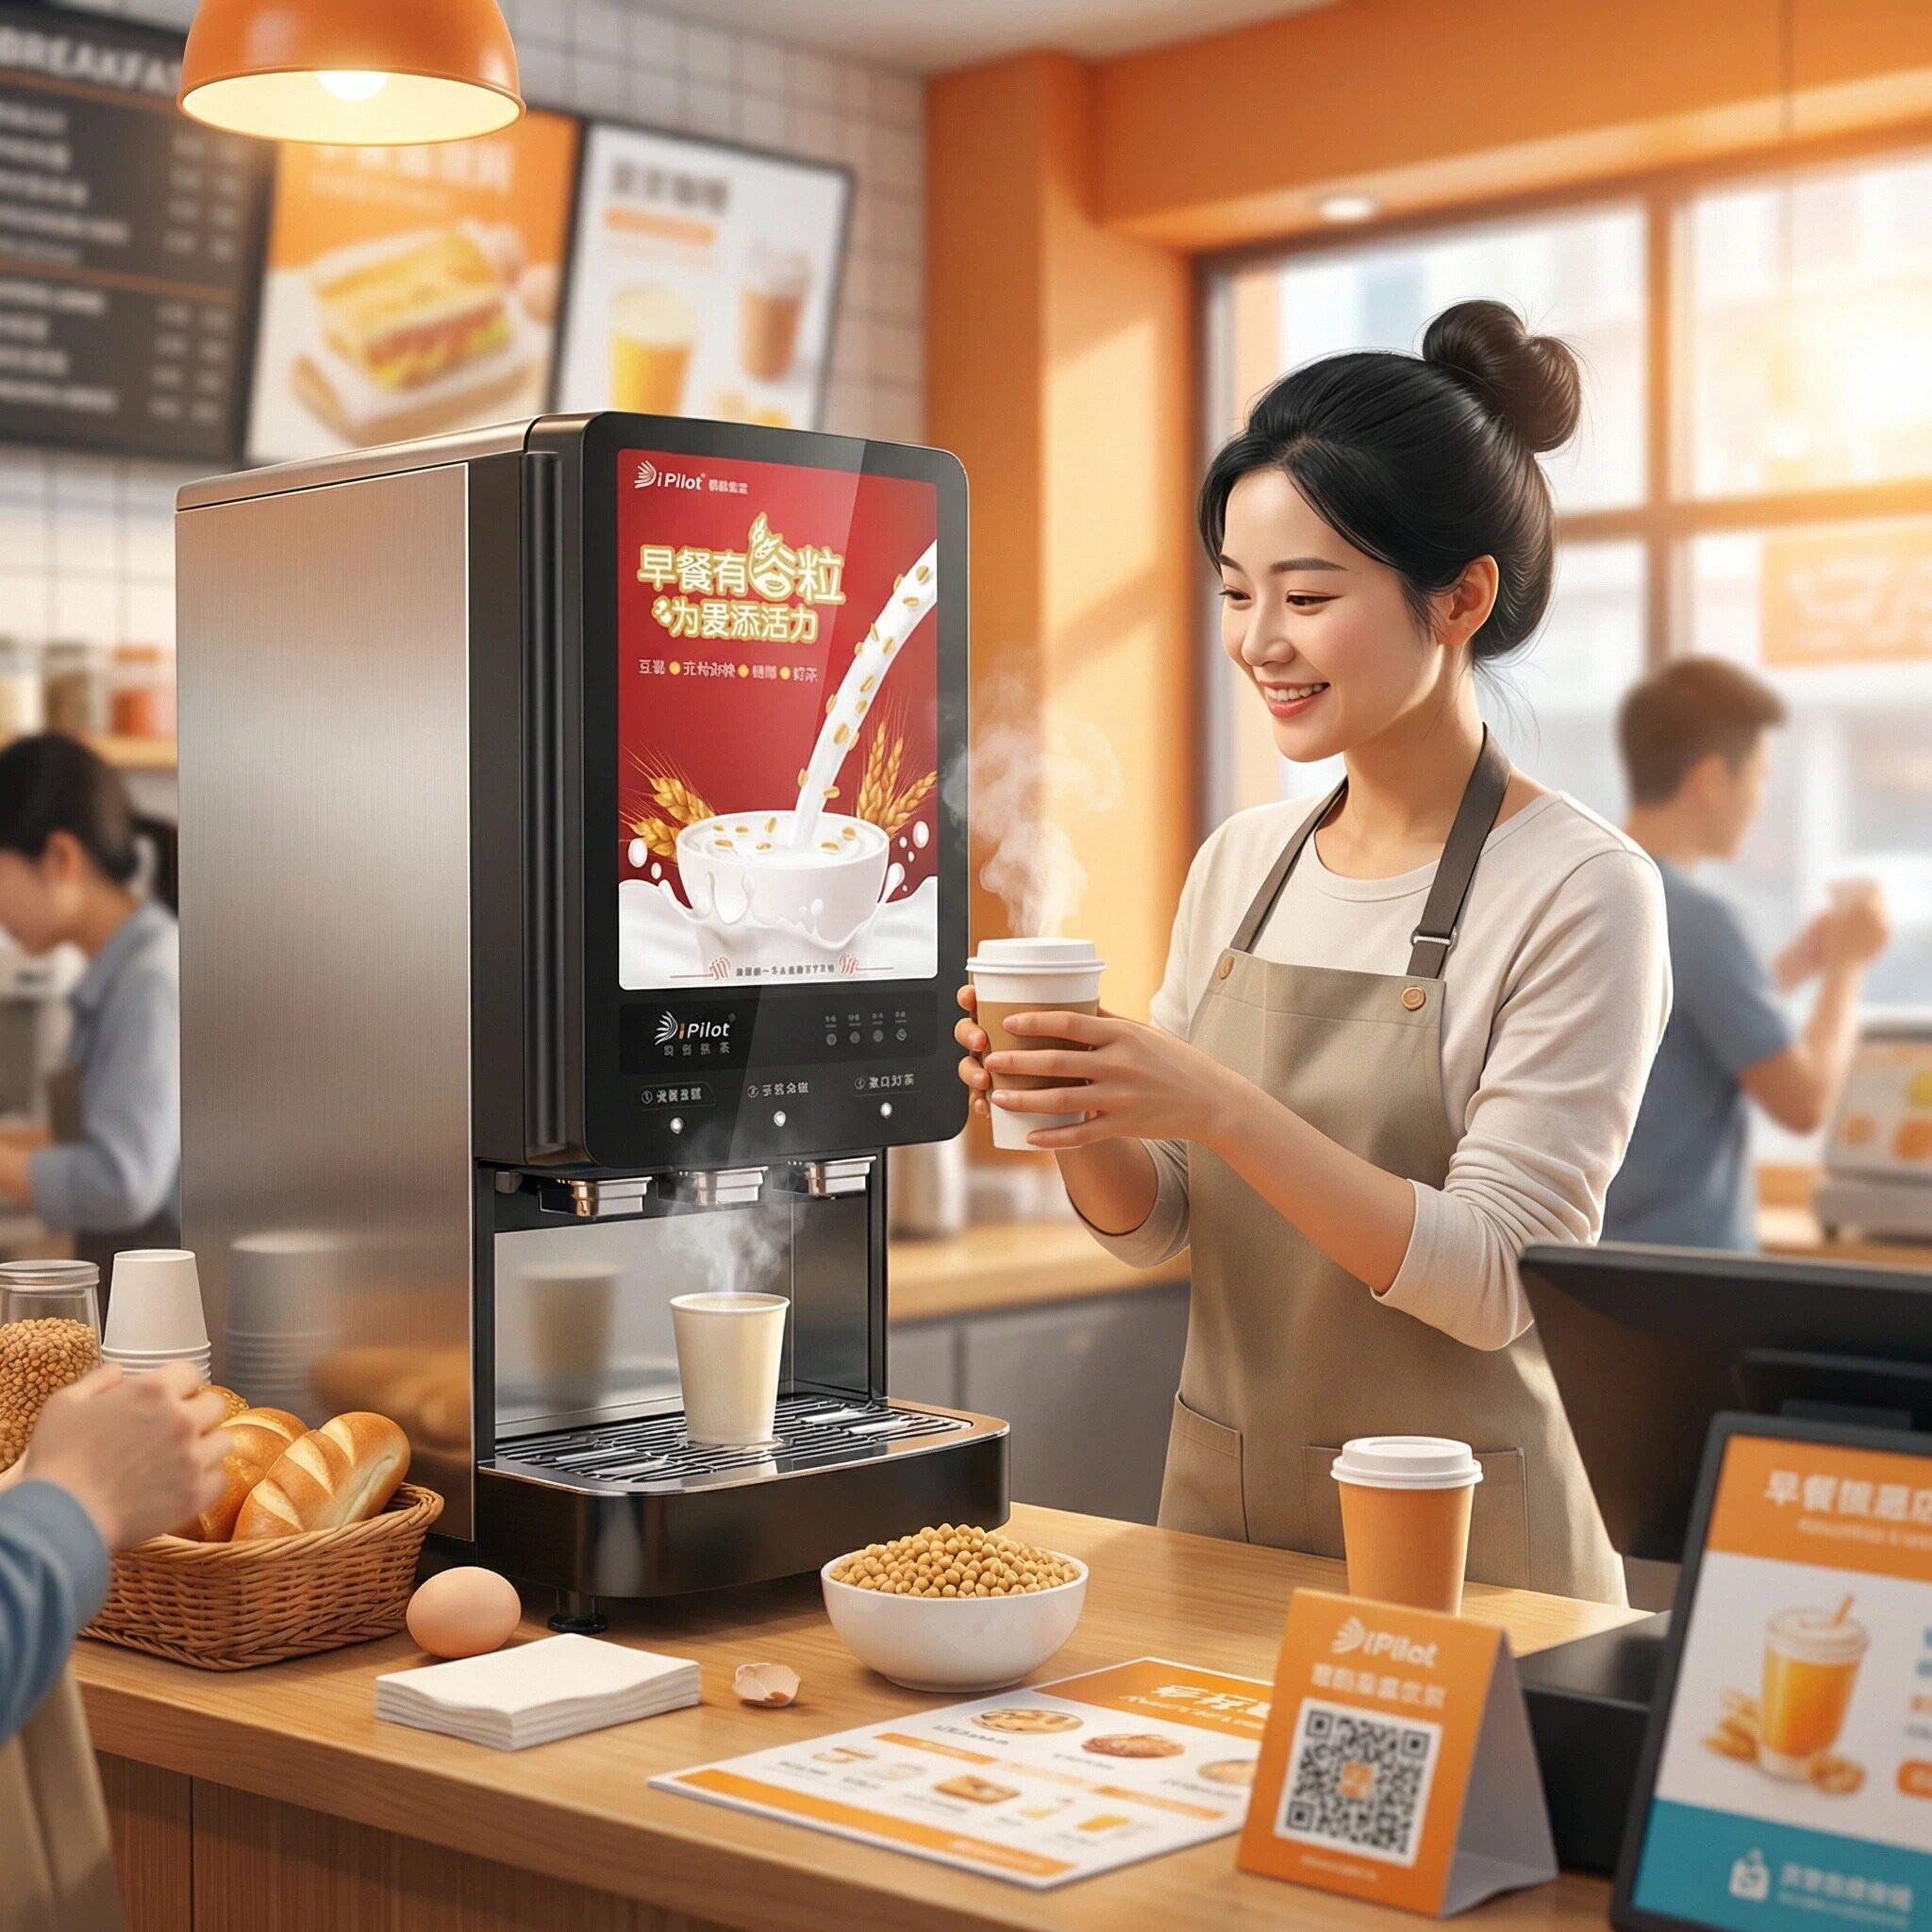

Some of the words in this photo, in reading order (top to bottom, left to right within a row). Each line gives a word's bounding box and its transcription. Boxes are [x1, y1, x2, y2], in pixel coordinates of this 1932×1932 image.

[638, 513, 846, 605] 早餐有谷粒
[678, 1021, 731, 1040] iPilot
